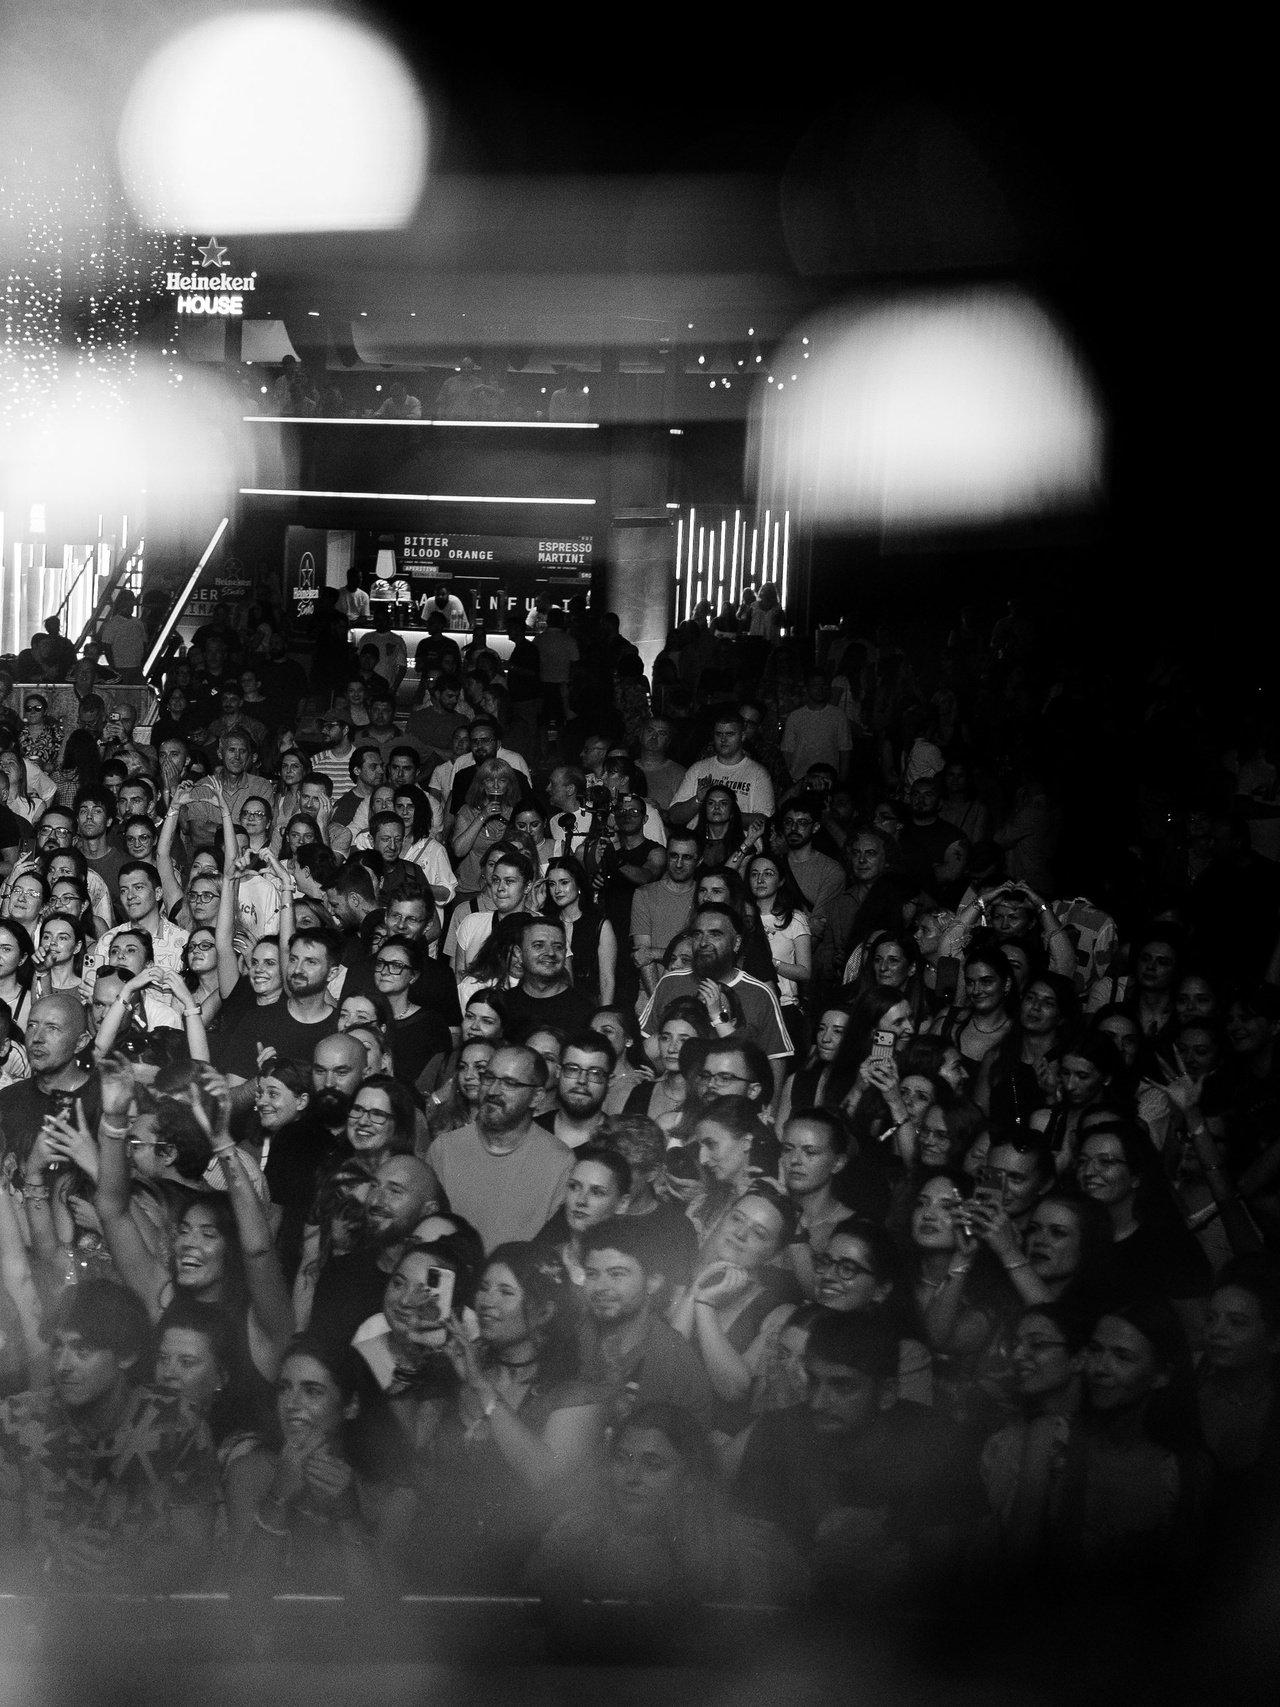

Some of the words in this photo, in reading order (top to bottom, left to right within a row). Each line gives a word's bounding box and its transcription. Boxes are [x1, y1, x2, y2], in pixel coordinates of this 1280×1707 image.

[166, 272, 255, 290] Heineken
[177, 296, 243, 314] HOUSE
[404, 536, 449, 547] BITTER
[538, 541, 592, 553] ESPRESSO
[403, 548, 441, 558] BLOOD
[448, 550, 494, 560] ORANGE
[538, 553, 584, 563] MARTINI
[725, 780, 751, 792] STONES
